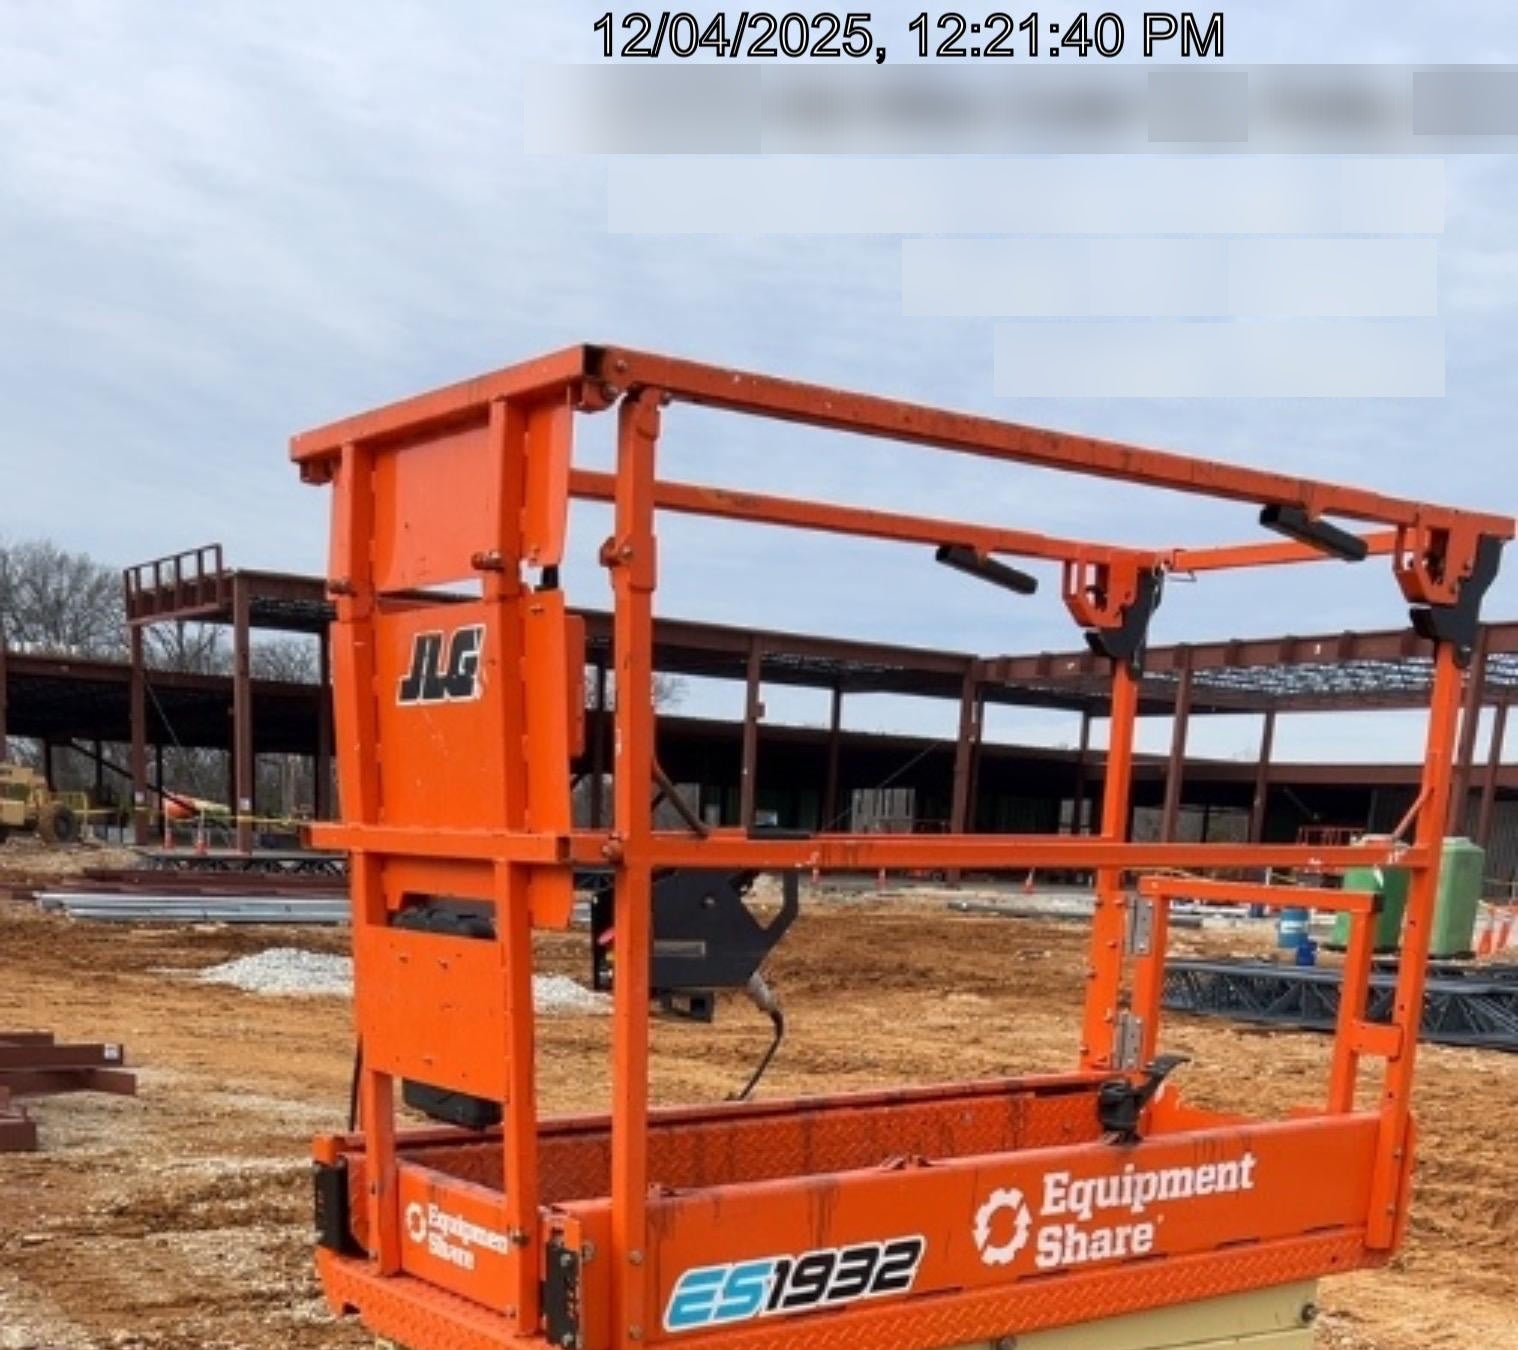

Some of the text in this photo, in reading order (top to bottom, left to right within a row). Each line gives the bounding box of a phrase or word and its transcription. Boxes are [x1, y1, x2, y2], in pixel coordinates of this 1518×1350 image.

[396, 623, 486, 706] JLG
[1040, 1151, 1257, 1222] Equipment
[427, 1202, 509, 1256] Equipmen
[1035, 1222, 1154, 1269] Share
[664, 1235, 925, 1332] ES1932
